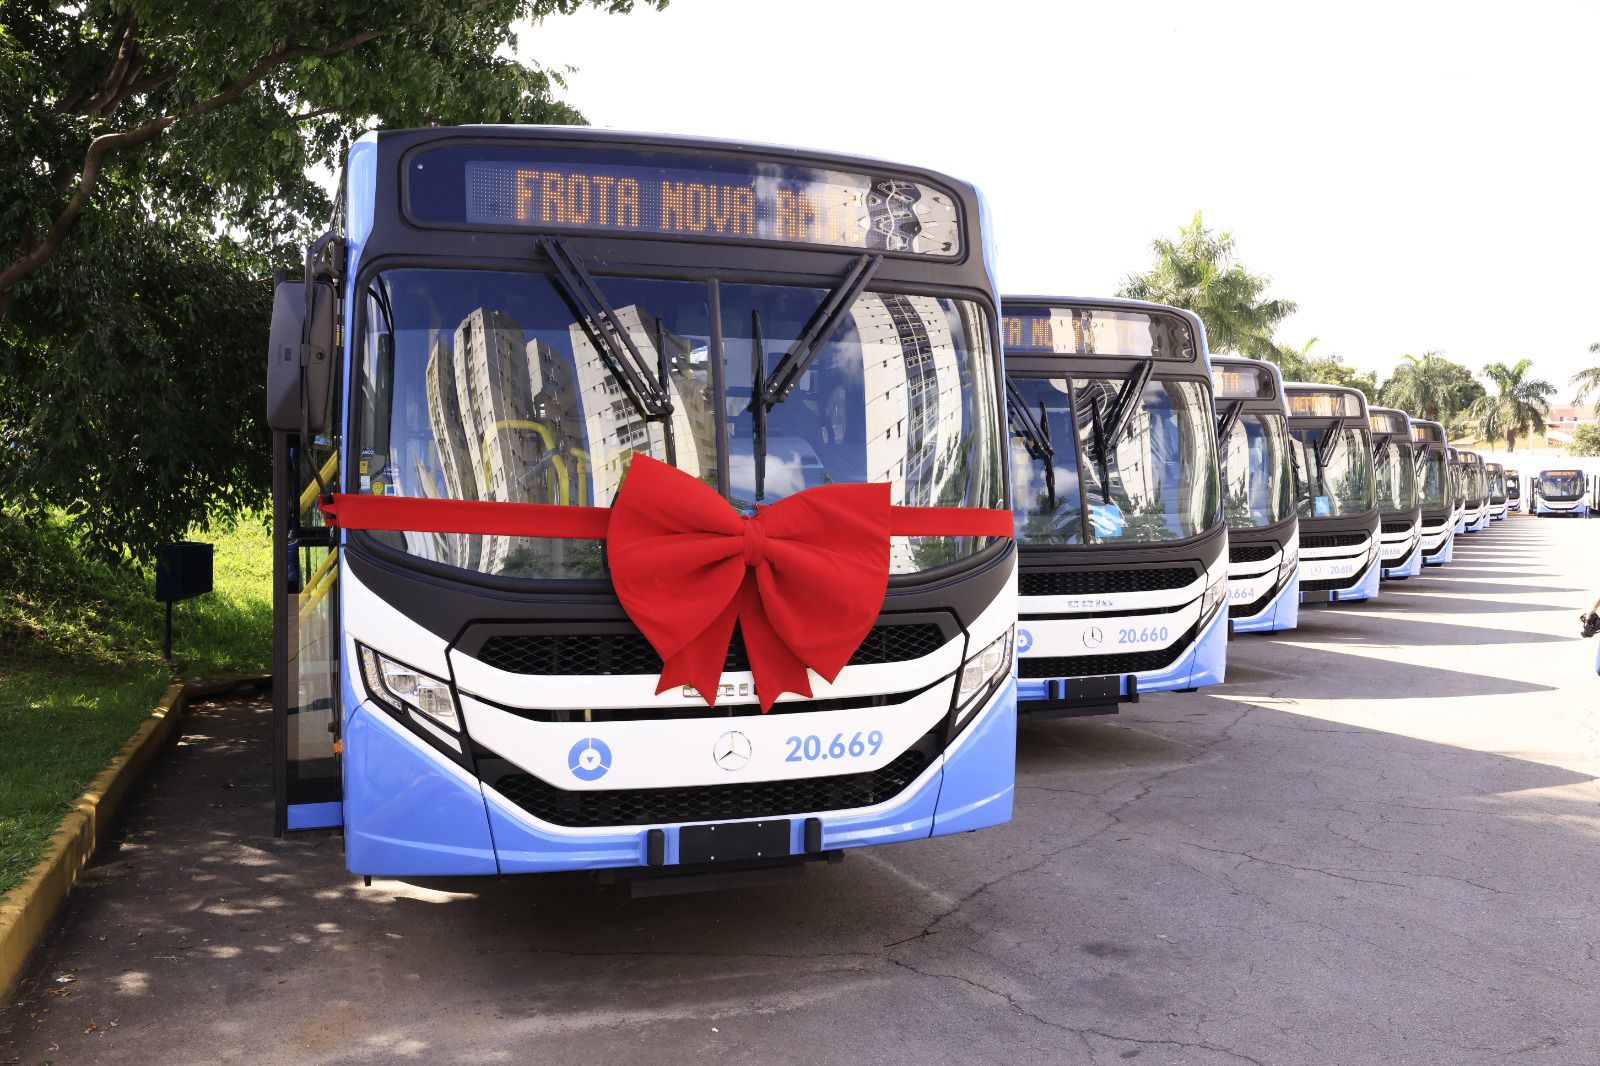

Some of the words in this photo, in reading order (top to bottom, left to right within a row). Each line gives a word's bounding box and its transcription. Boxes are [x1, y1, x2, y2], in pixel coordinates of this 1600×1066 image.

[515, 169, 639, 228] FROTA
[660, 178, 753, 235] NOVA
[1118, 626, 1168, 645] 20.660
[784, 730, 884, 763] 20.669
